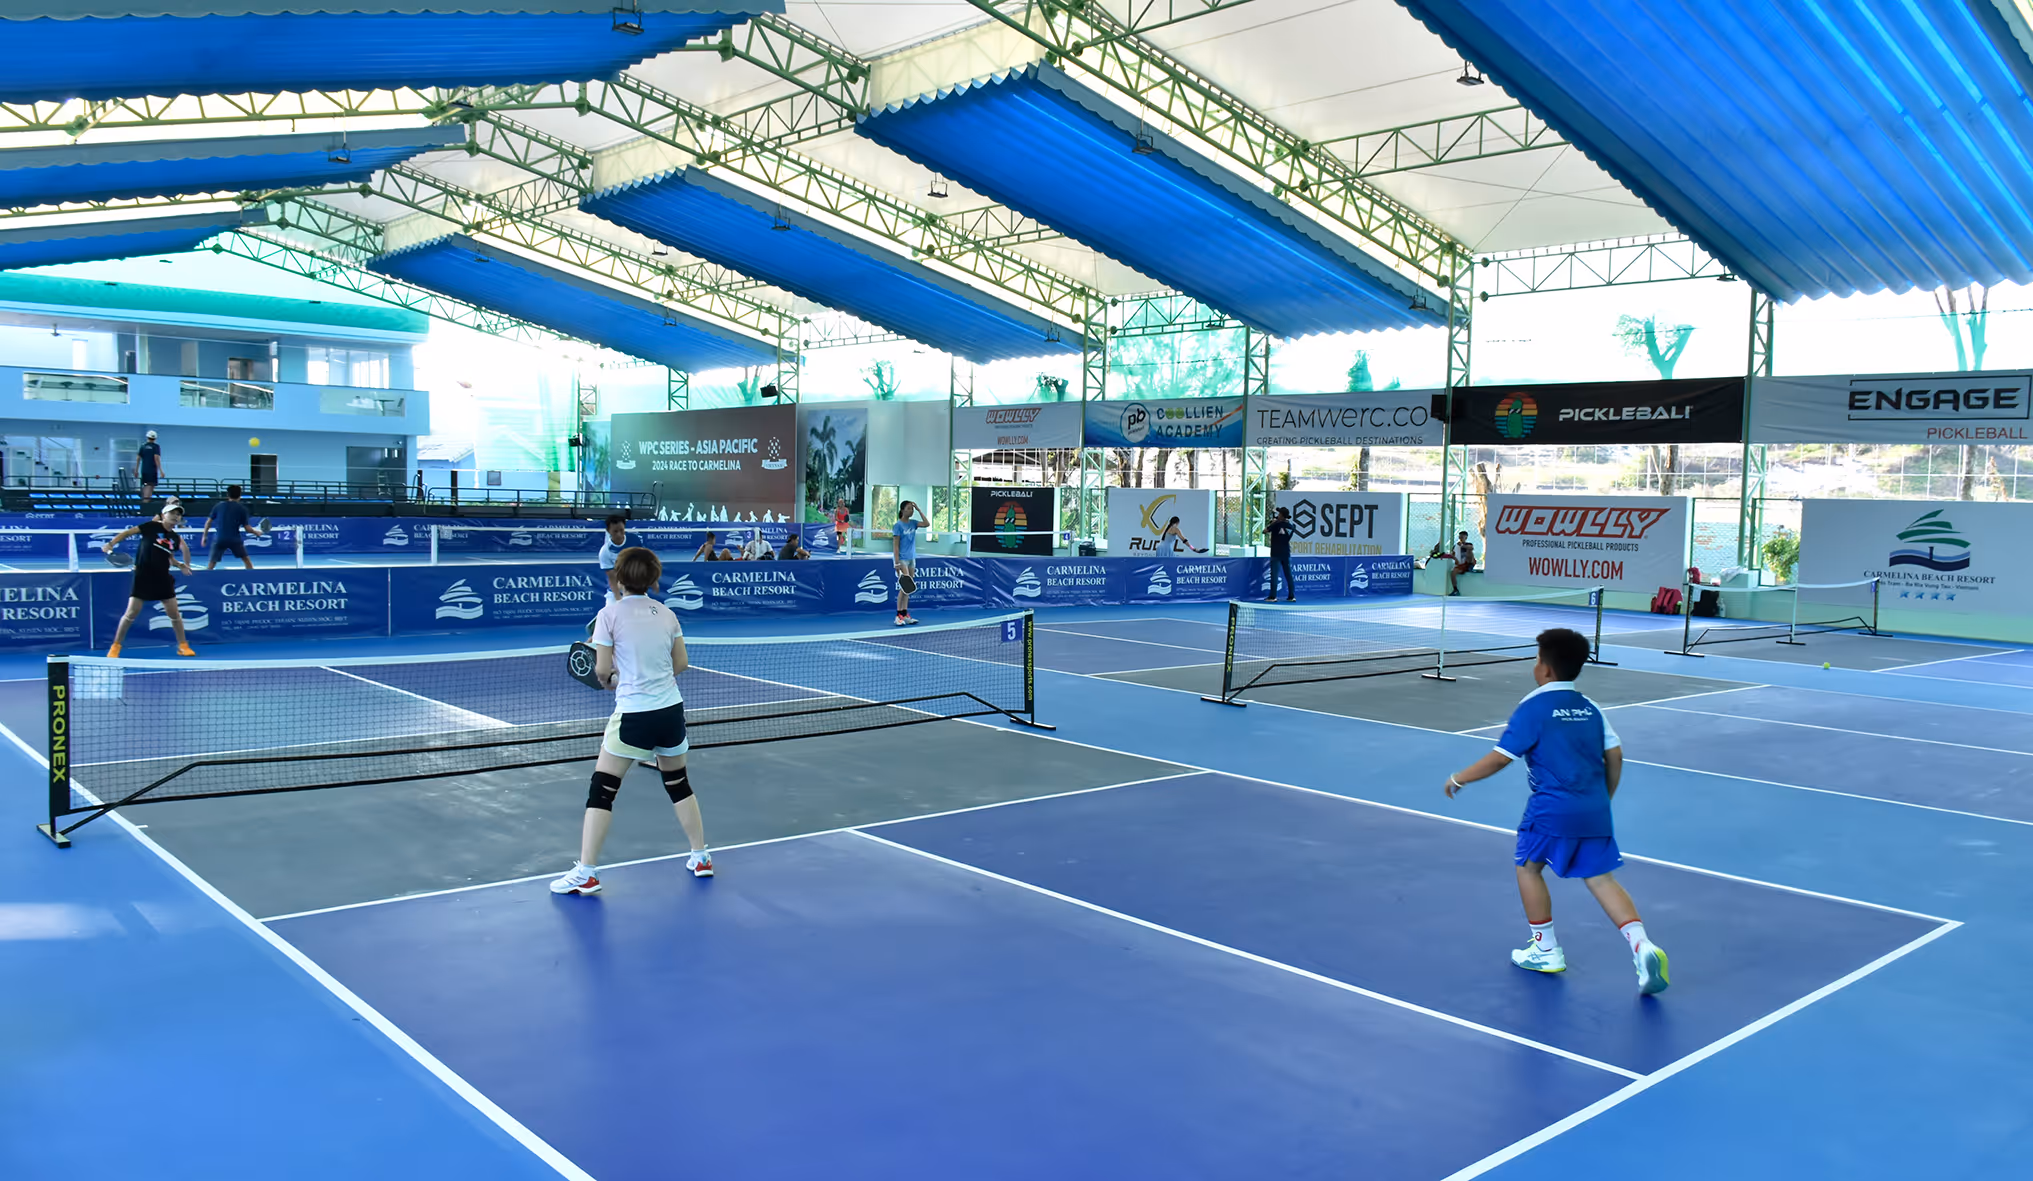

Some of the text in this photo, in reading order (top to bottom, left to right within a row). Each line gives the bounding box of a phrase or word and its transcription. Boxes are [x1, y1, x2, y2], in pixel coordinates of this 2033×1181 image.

[1848, 387, 2021, 412] ENGAGE
[985, 408, 1042, 424] WOWLLY
[1127, 408, 1146, 430] pb
[1156, 424, 1223, 438] ACADEMY
[1927, 427, 2028, 439] PICKLEBALL
[638, 441, 659, 455] WPC
[659, 440, 690, 455] SERIES
[695, 439, 718, 454] ASIA
[719, 438, 759, 453] PACIFIC
[1257, 436, 1423, 445] CREATING PICKLEBALL DESTINATIONS
[652, 459, 741, 471] 2024 RACE TO CARMELINA
[1320, 503, 1379, 539] SEPT
[1495, 505, 1672, 539] WOWLLY
[283, 531, 290, 540] 2
[1522, 539, 1639, 552] PROFESSIONAL PICKLEBALL PRODUCTS
[1047, 565, 1106, 576] CARMELINA
[1176, 565, 1227, 574] CARMELINA
[1291, 563, 1331, 572] ARMELINA
[1371, 561, 1411, 570] CARMELINA
[1528, 557, 1624, 580] WOWLLY.COM
[711, 571, 796, 583] CARMELINA
[895, 567, 964, 578] RMELINA
[1308, 573, 1331, 581] RESORT
[1391, 571, 1410, 579] RESORT
[1863, 570, 1996, 584] CARMELINA BEACH RESORT
[492, 575, 593, 589] CARMELINA
[930, 580, 964, 589] RESORT
[1047, 577, 1106, 586] BEACH RESORT
[1176, 576, 1227, 584] BEACH RESORT
[220, 581, 347, 597] CARMELINA
[712, 585, 797, 597] BEACH RESORT
[493, 590, 594, 604] BEACH RESORT
[1590, 592, 1596, 605] 6
[222, 598, 348, 613] BEACH RESORT
[2, 607, 80, 620] RESORT
[1007, 621, 1016, 640] 5
[1552, 708, 1571, 717] AN
[53, 685, 66, 783] PRONEX
